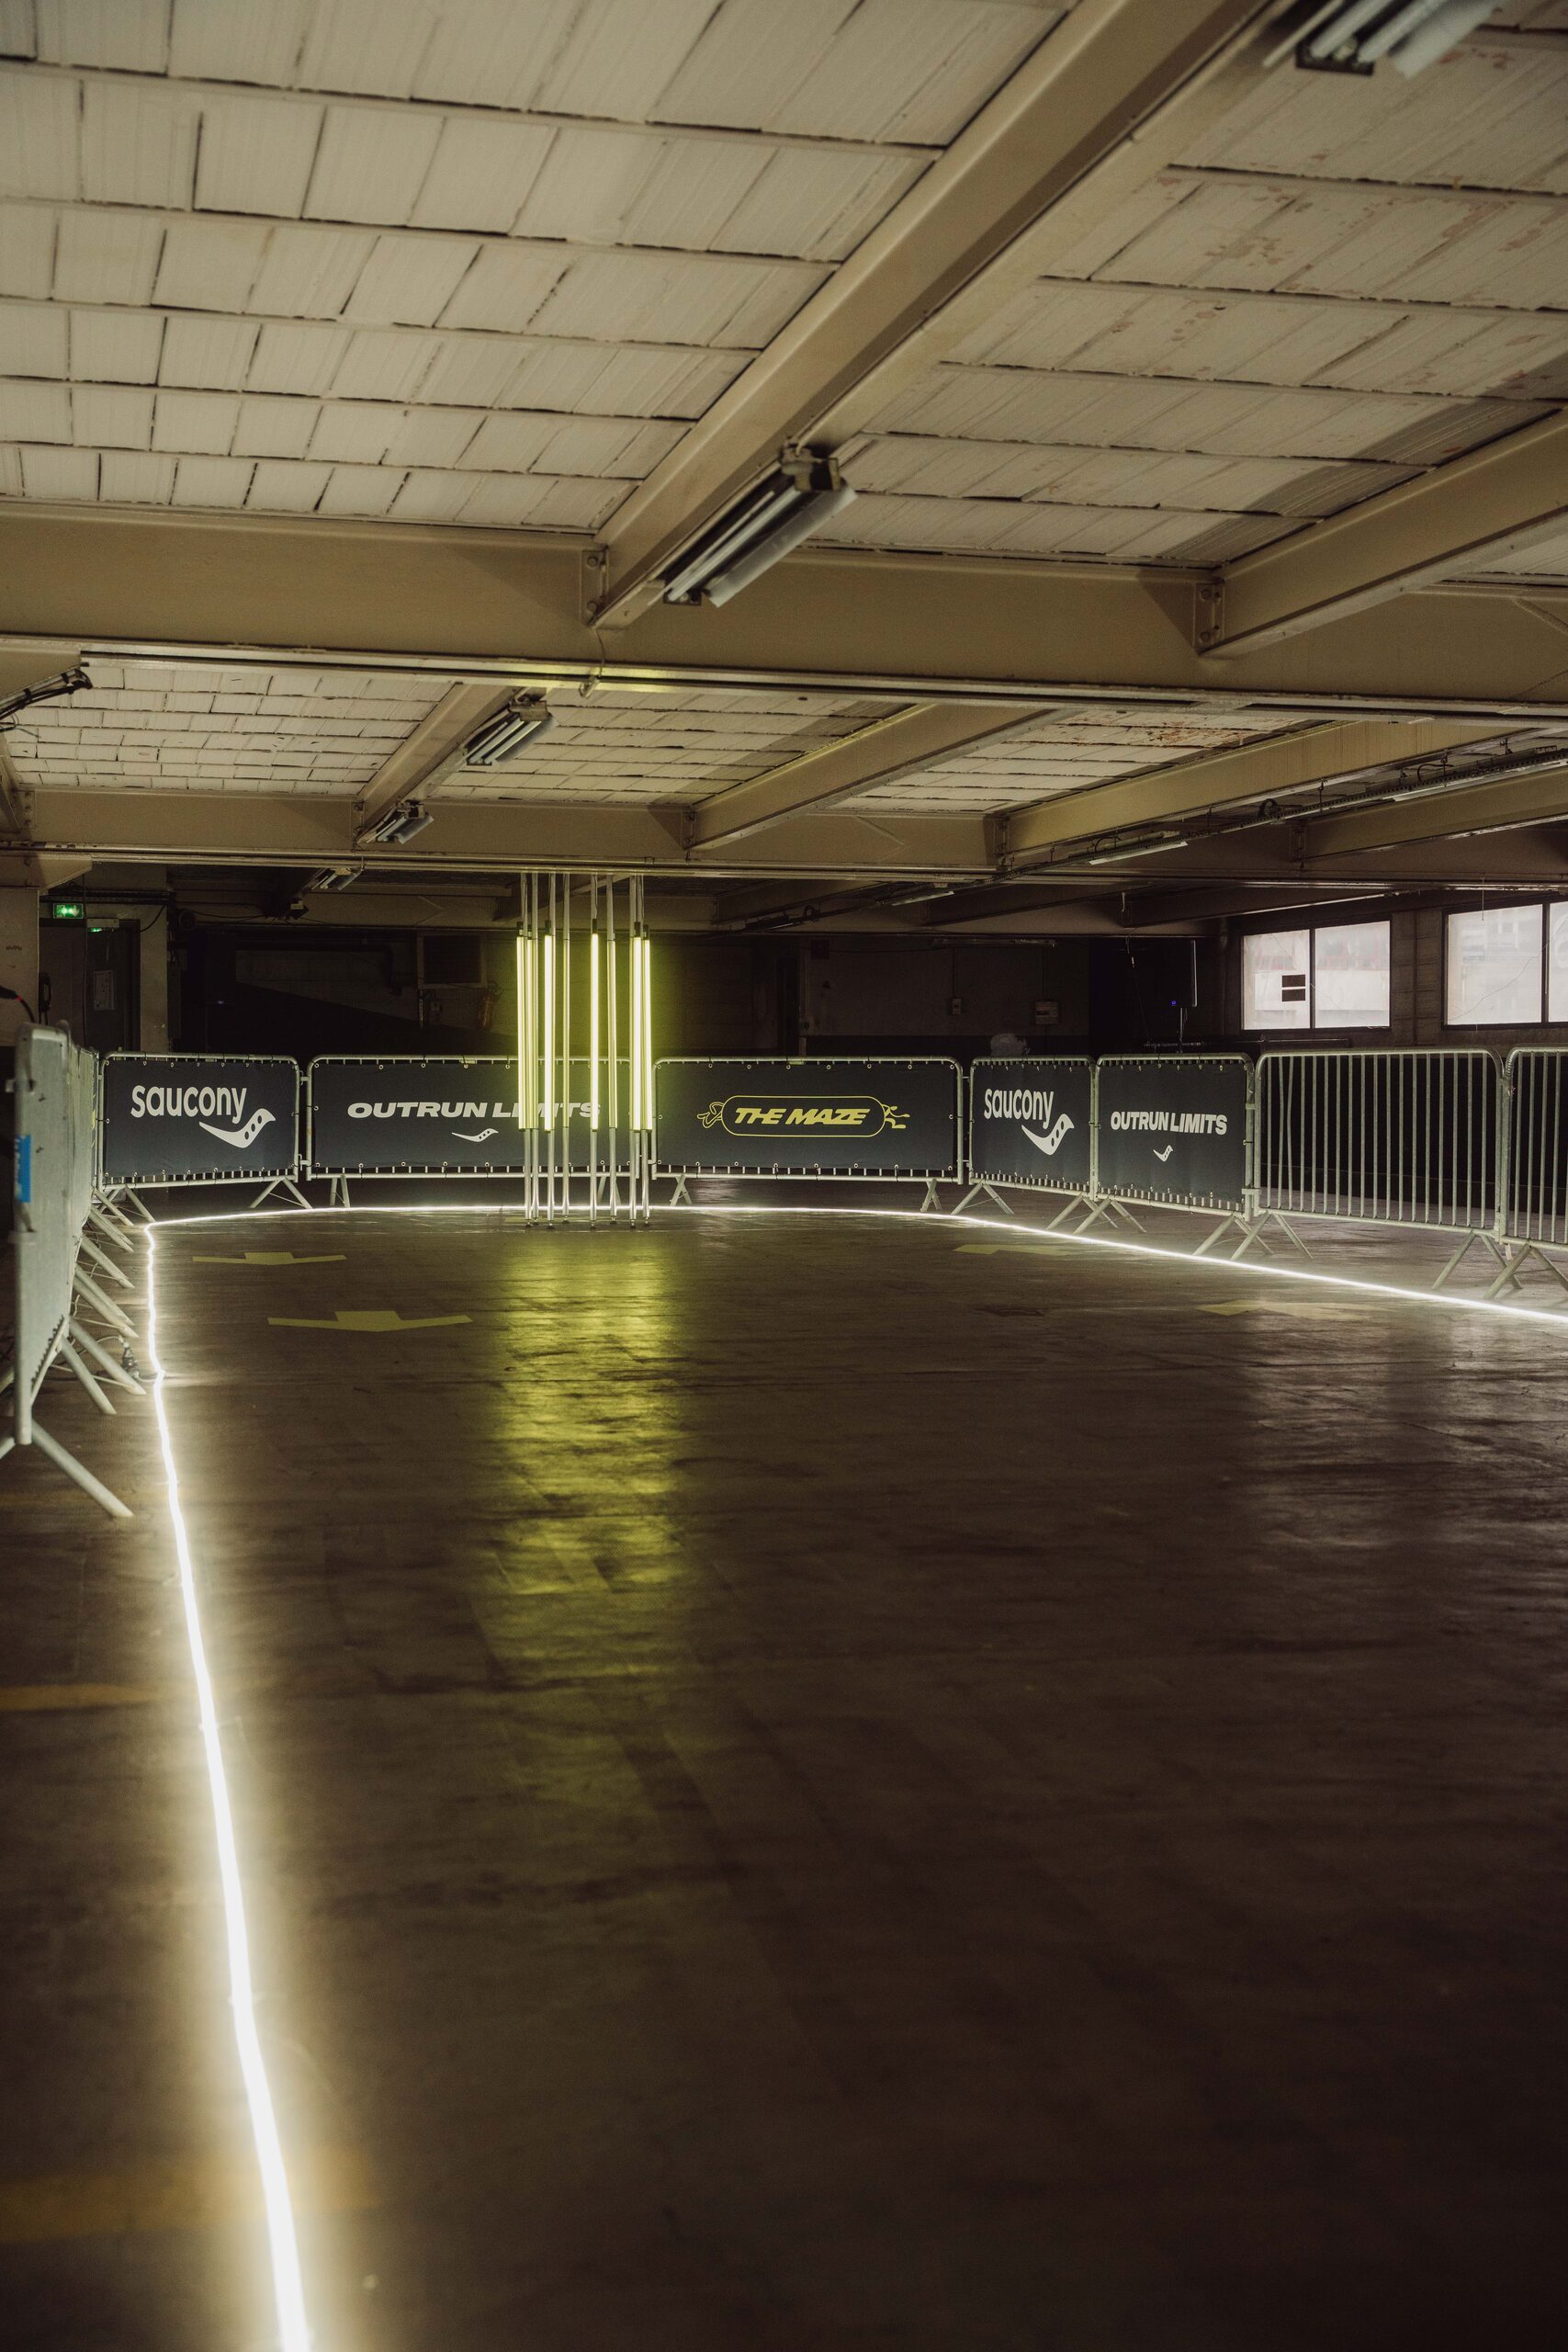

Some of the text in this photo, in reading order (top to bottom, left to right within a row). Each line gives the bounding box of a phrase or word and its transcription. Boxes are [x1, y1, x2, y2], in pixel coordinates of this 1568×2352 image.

[130, 1084, 247, 1125] saucony
[347, 1102, 601, 1118] OUTRUN LITS
[734, 1107, 871, 1125] THE MAZE
[984, 1088, 1054, 1129] saucony
[1111, 1111, 1228, 1136] OUTRUN LIMITS
